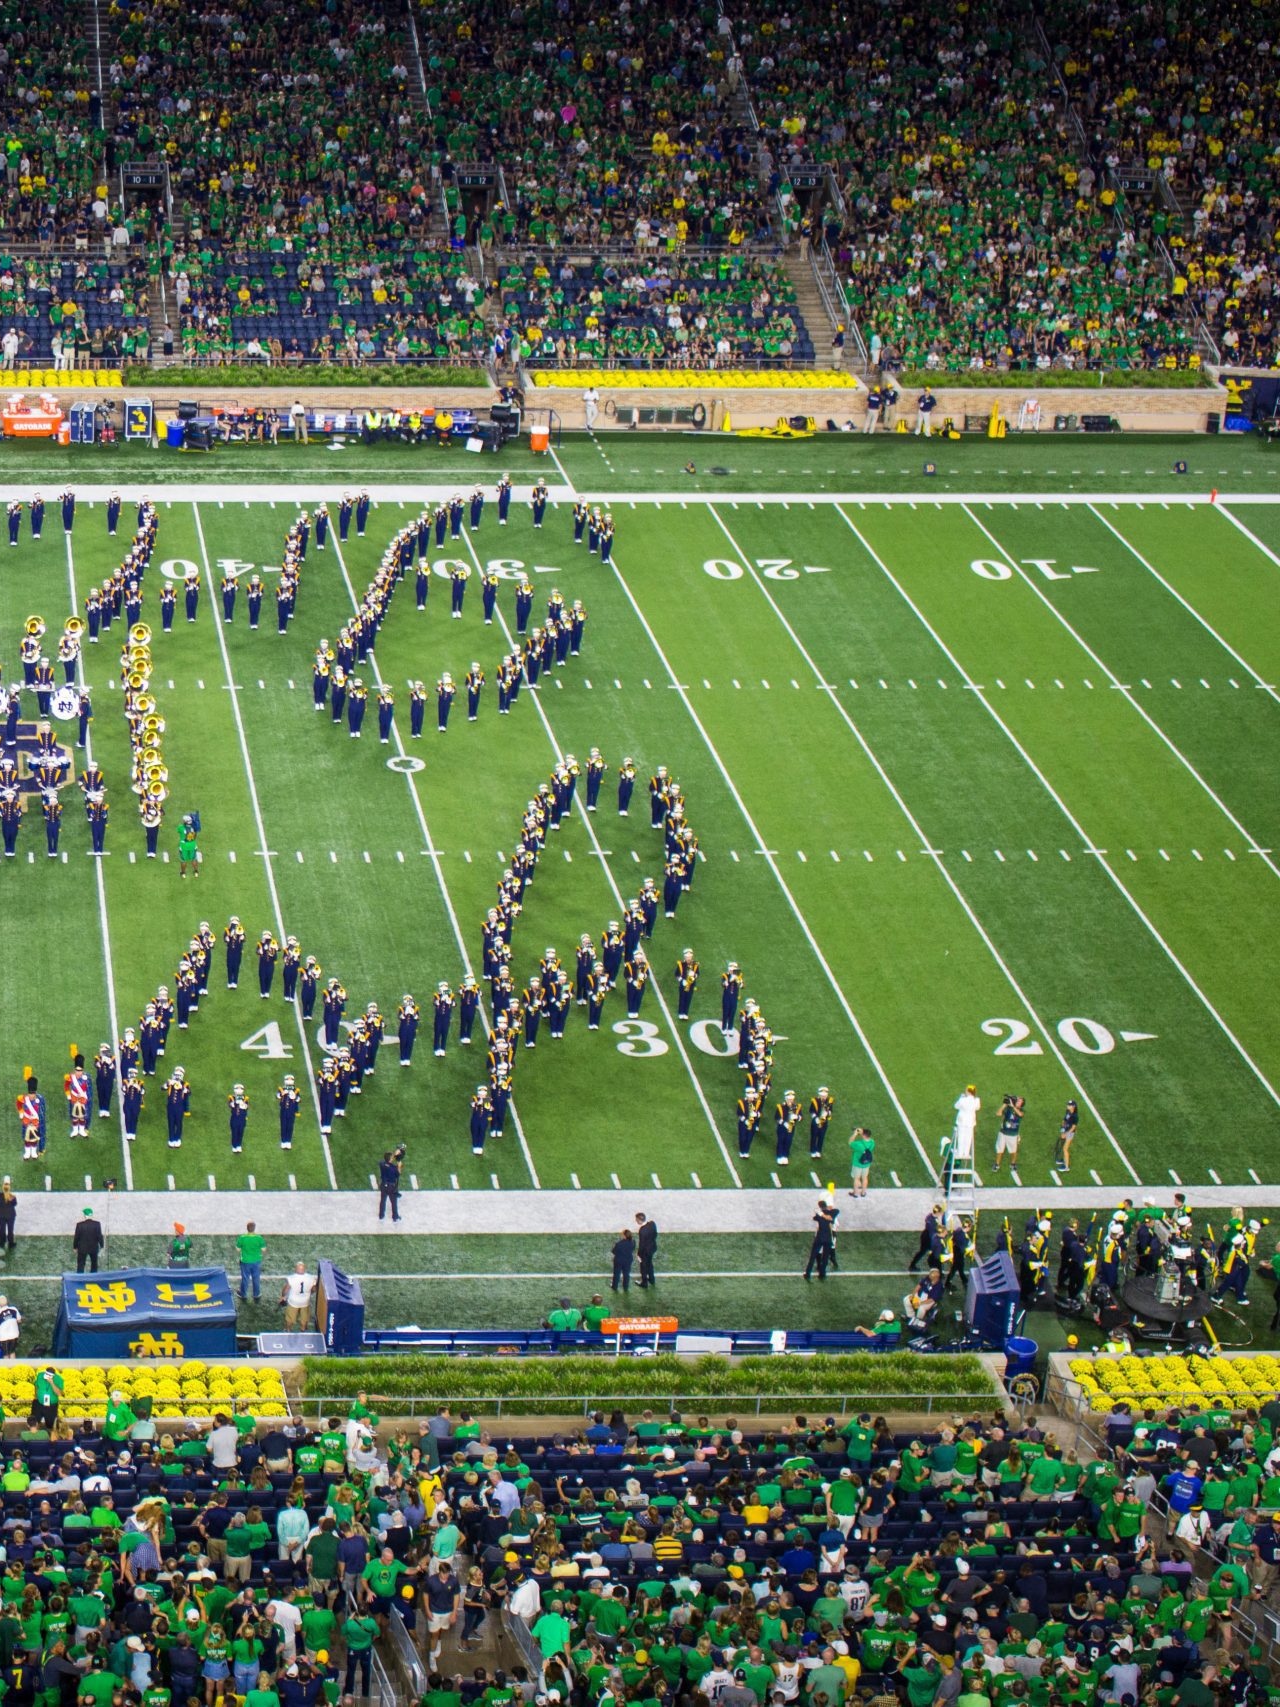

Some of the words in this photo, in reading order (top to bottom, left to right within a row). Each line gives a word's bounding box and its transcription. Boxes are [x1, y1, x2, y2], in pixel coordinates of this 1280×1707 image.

[160, 559, 255, 580] 40
[703, 559, 800, 580] 20
[970, 560, 1072, 581] 10
[613, 1020, 742, 1057] 30
[980, 1018, 1115, 1055] 20
[299, 1281, 305, 1294] 1
[76, 1281, 137, 1314] ND
[150, 1301, 181, 1309] UNDER
[183, 1301, 224, 1310] ARMOUR
[618, 1323, 661, 1331] GATORADE
[851, 1596, 866, 1611] 87
[1090, 1647, 1100, 1662] 9
[12, 1669, 23, 1688] 7
[783, 1674, 794, 1682] 17
